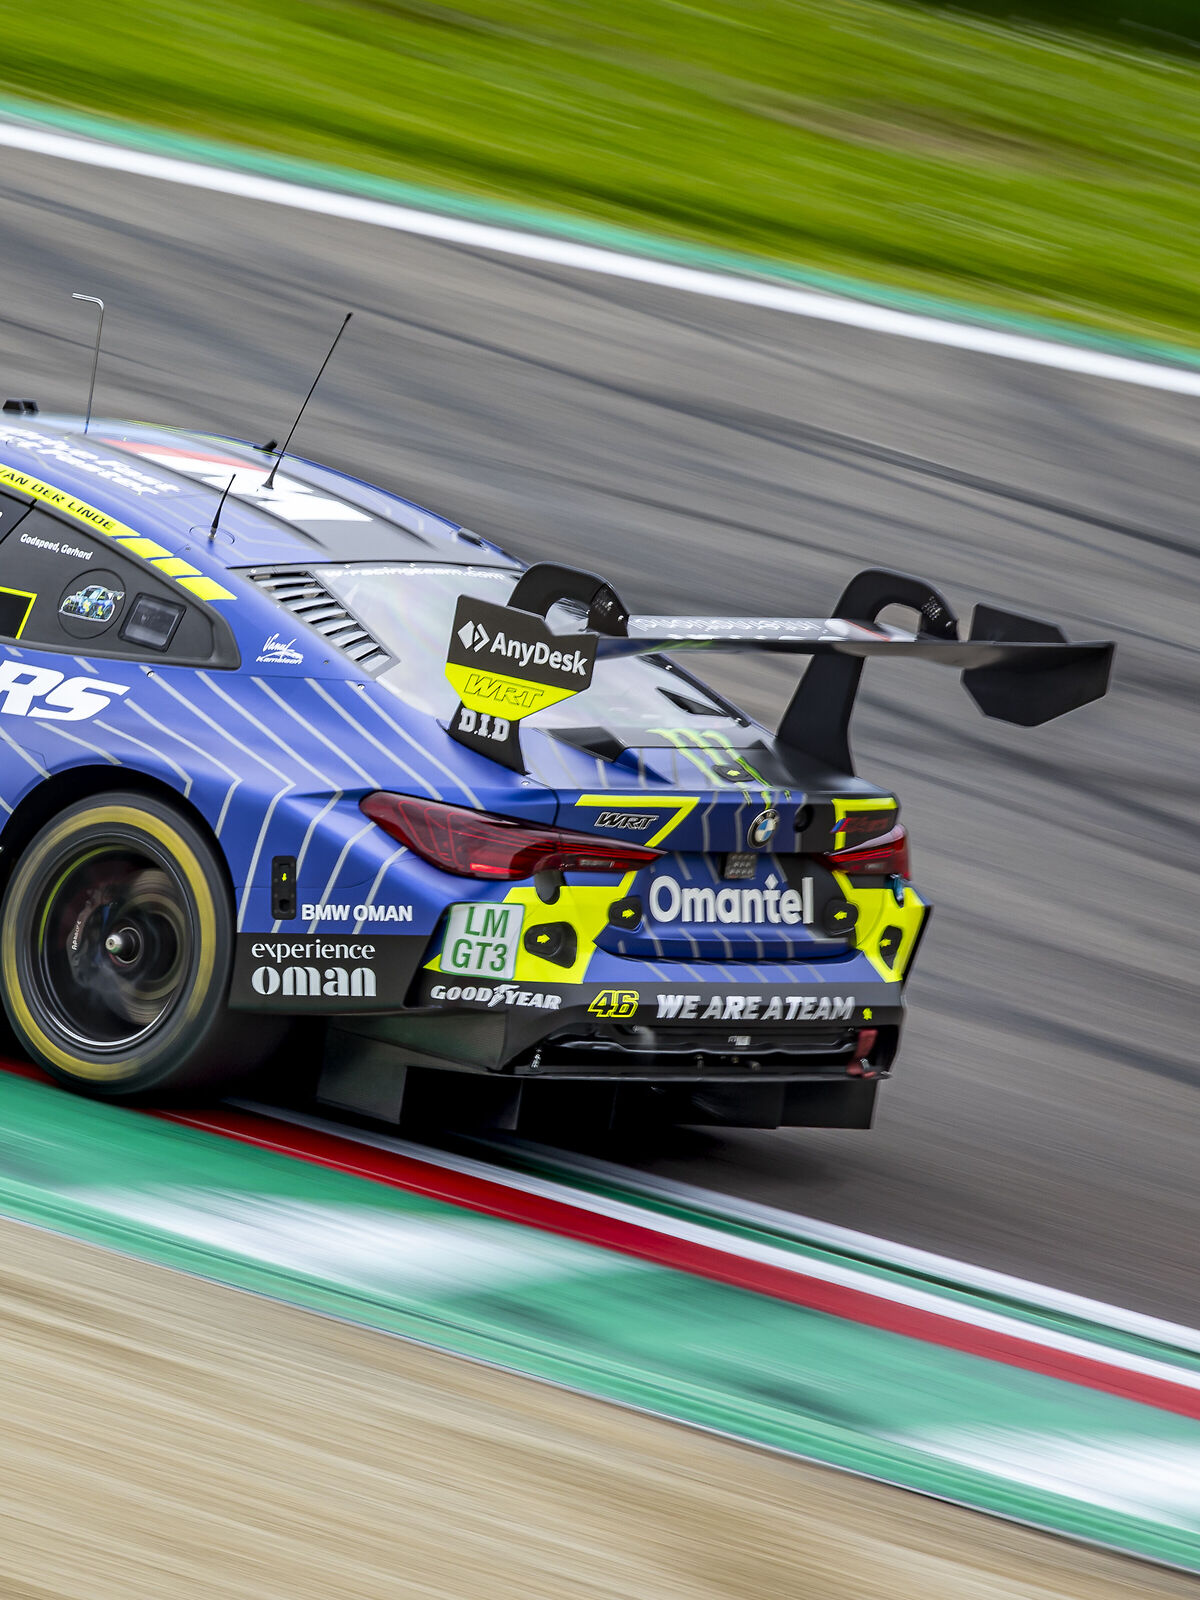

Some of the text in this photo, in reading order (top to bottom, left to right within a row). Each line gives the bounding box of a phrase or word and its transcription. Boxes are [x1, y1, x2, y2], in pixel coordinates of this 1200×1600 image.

[20, 533, 94, 561] Godspeed, Gerhard
[490, 631, 589, 677] AnyDesk
[464, 672, 545, 709] WRT
[593, 811, 660, 830] WRT
[301, 903, 414, 923] BMW OMAN
[649, 874, 815, 925] Omantel
[463, 906, 510, 939] LM
[251, 938, 376, 964] experience
[451, 939, 508, 972] GT3
[251, 966, 377, 997] oman
[587, 989, 640, 1019] 46
[656, 994, 701, 1020] WE
[700, 995, 758, 1020] ARE
